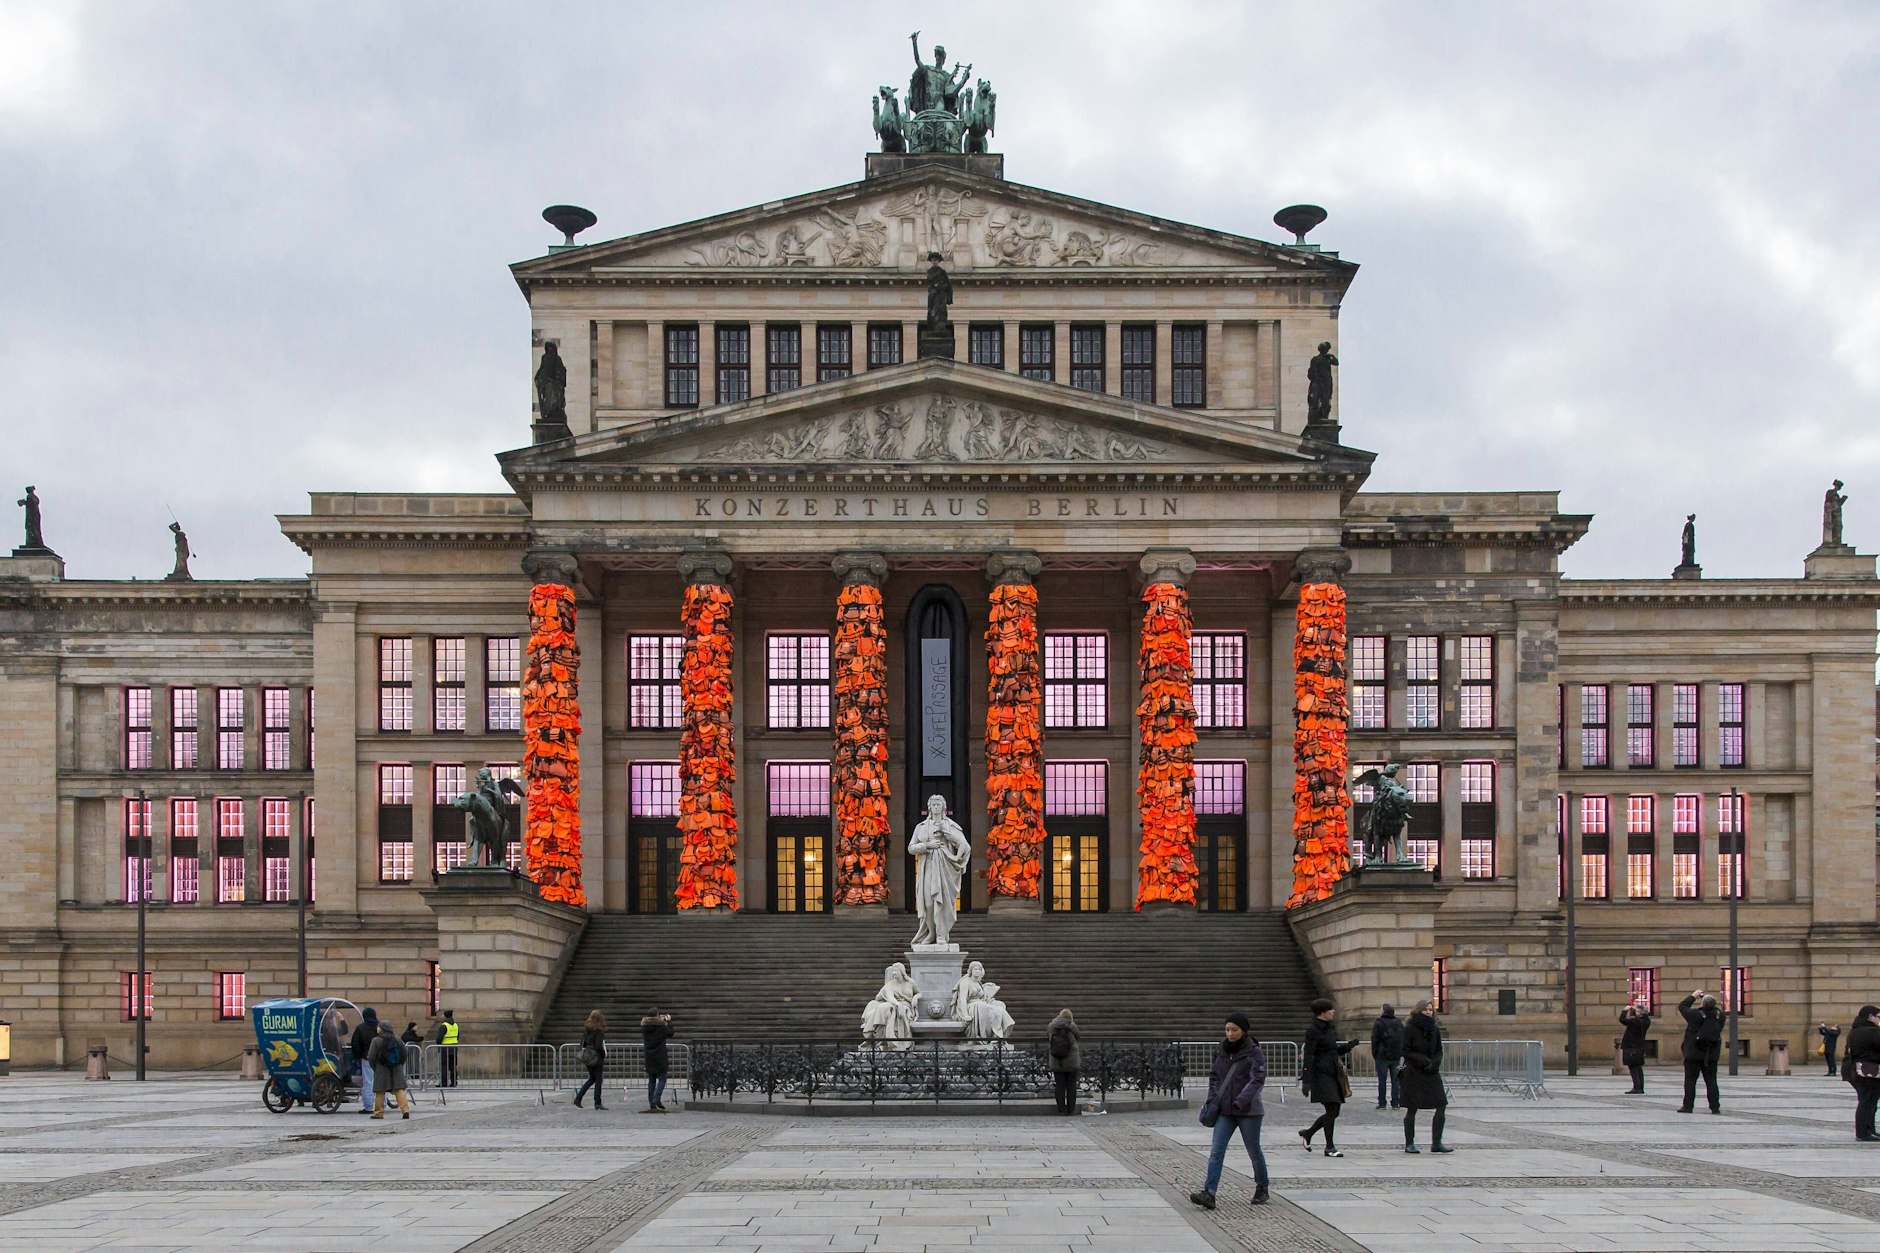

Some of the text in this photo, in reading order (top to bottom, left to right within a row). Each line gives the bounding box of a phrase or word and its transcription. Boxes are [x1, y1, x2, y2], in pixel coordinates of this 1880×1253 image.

[694, 497, 1180, 517] KONZERTHAUS BERLIN
[262, 1015, 297, 1029] GURAMI
